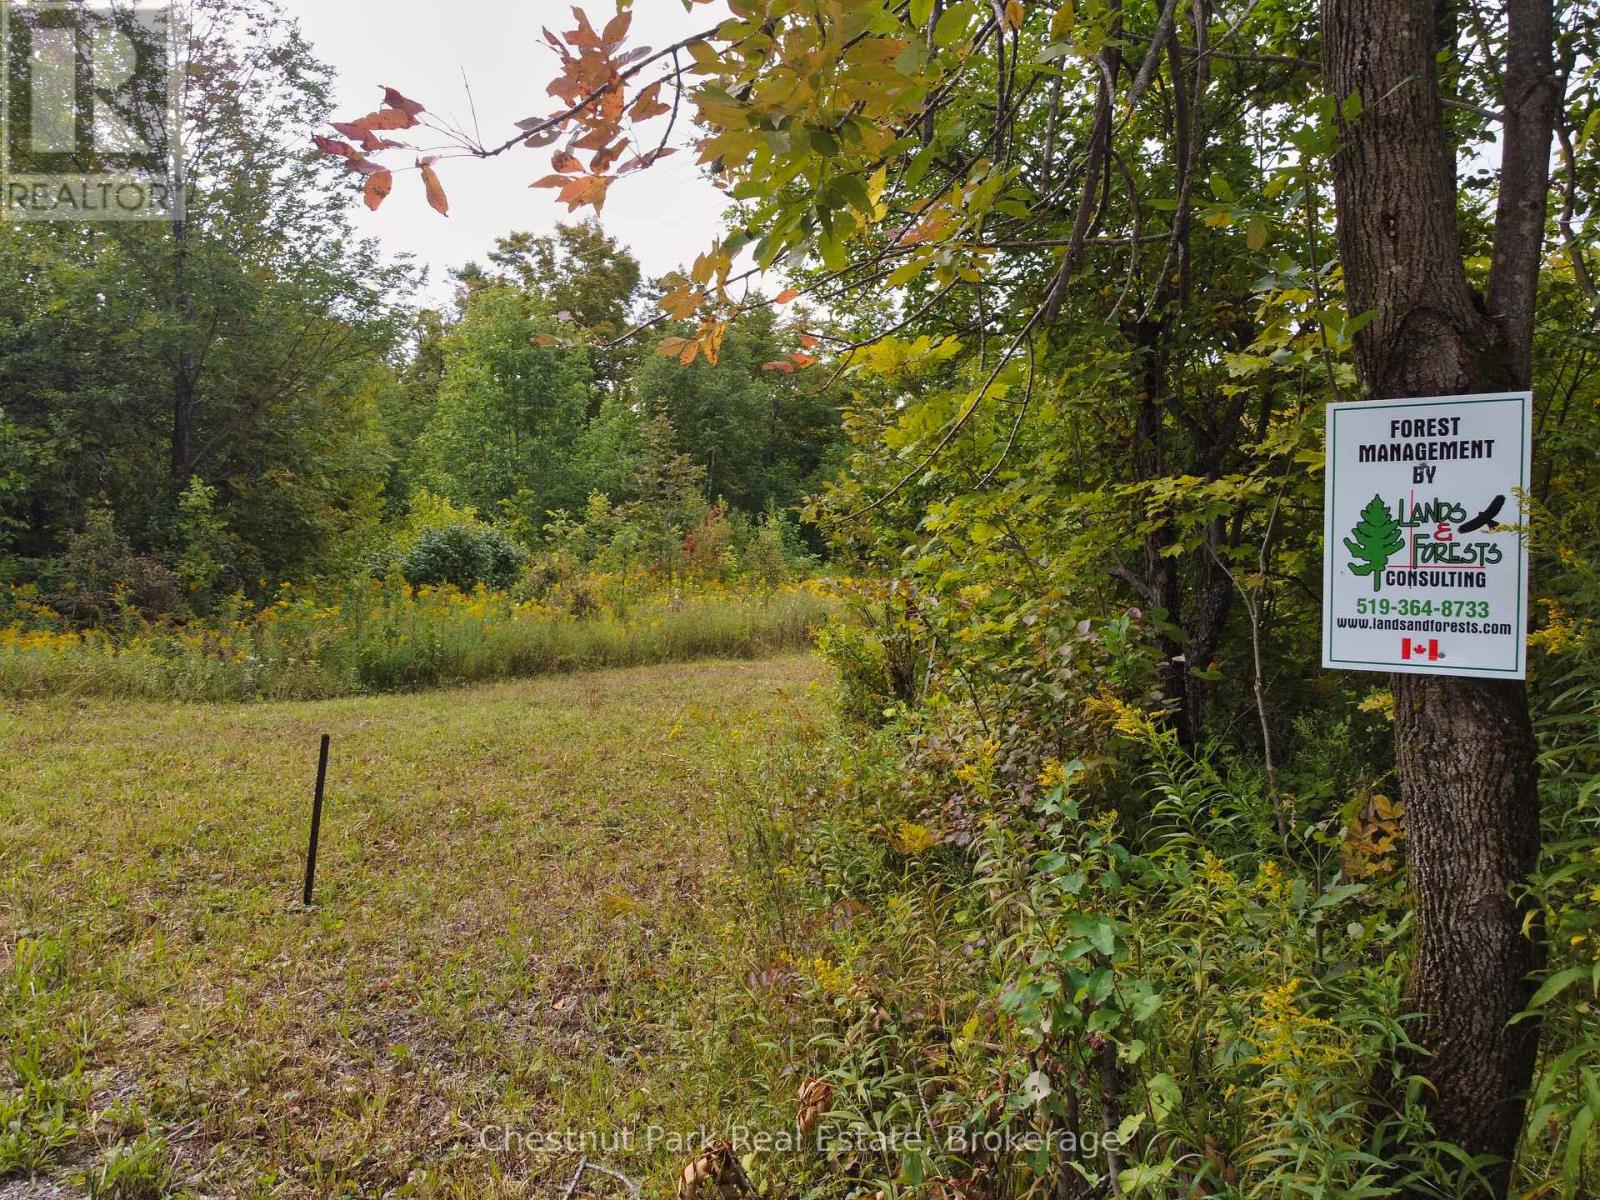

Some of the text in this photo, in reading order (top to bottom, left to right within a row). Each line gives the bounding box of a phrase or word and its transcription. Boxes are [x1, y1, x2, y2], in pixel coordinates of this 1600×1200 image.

[1390, 417, 1461, 438] FOREST
[1359, 440, 1495, 463] MANAGEMENT
[1412, 466, 1436, 484] BY
[1399, 498, 1467, 527] LANDS
[1433, 522, 1453, 541] &
[1413, 534, 1503, 569] FORESTS
[1386, 570, 1486, 588] CONSULTING
[1356, 598, 1490, 618] 519-364-8733
[1337, 617, 1511, 635] www.landsandforests.com
